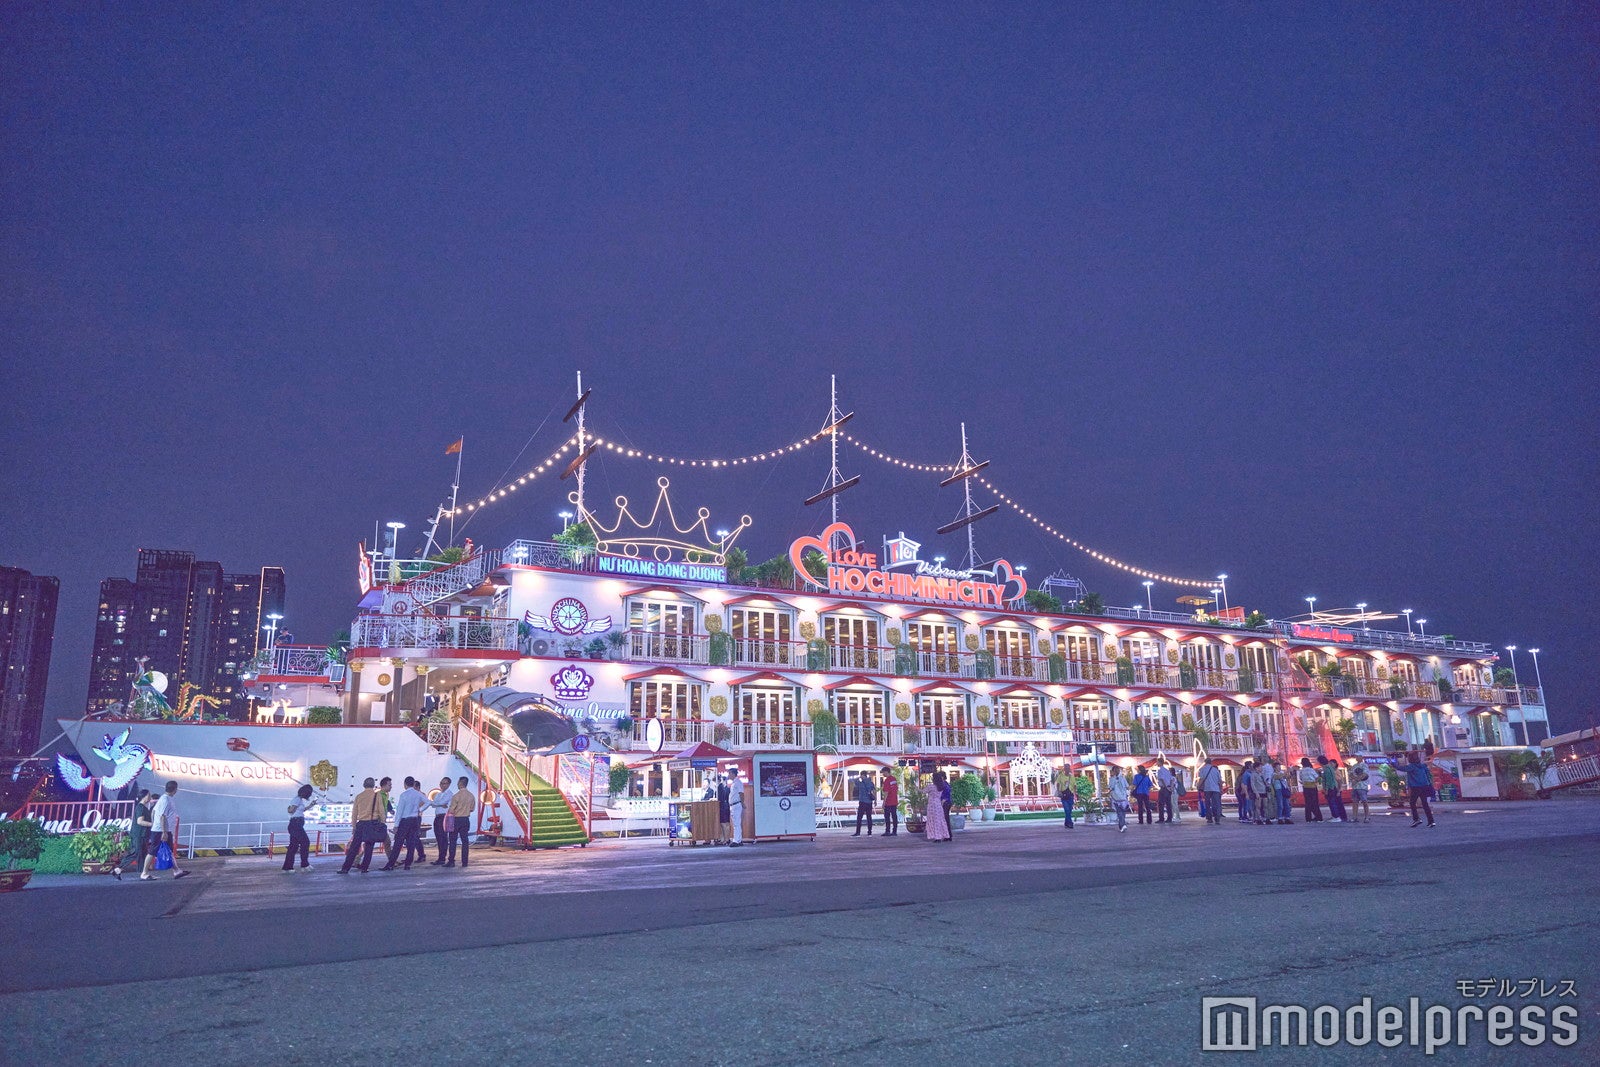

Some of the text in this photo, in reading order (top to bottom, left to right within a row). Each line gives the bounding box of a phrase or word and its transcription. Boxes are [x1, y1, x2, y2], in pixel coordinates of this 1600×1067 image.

[835, 549, 877, 569] LOVE
[916, 559, 974, 578] Vibrant
[588, 701, 626, 721] Queen
[155, 758, 293, 780] INDOCHINA QUEEN
